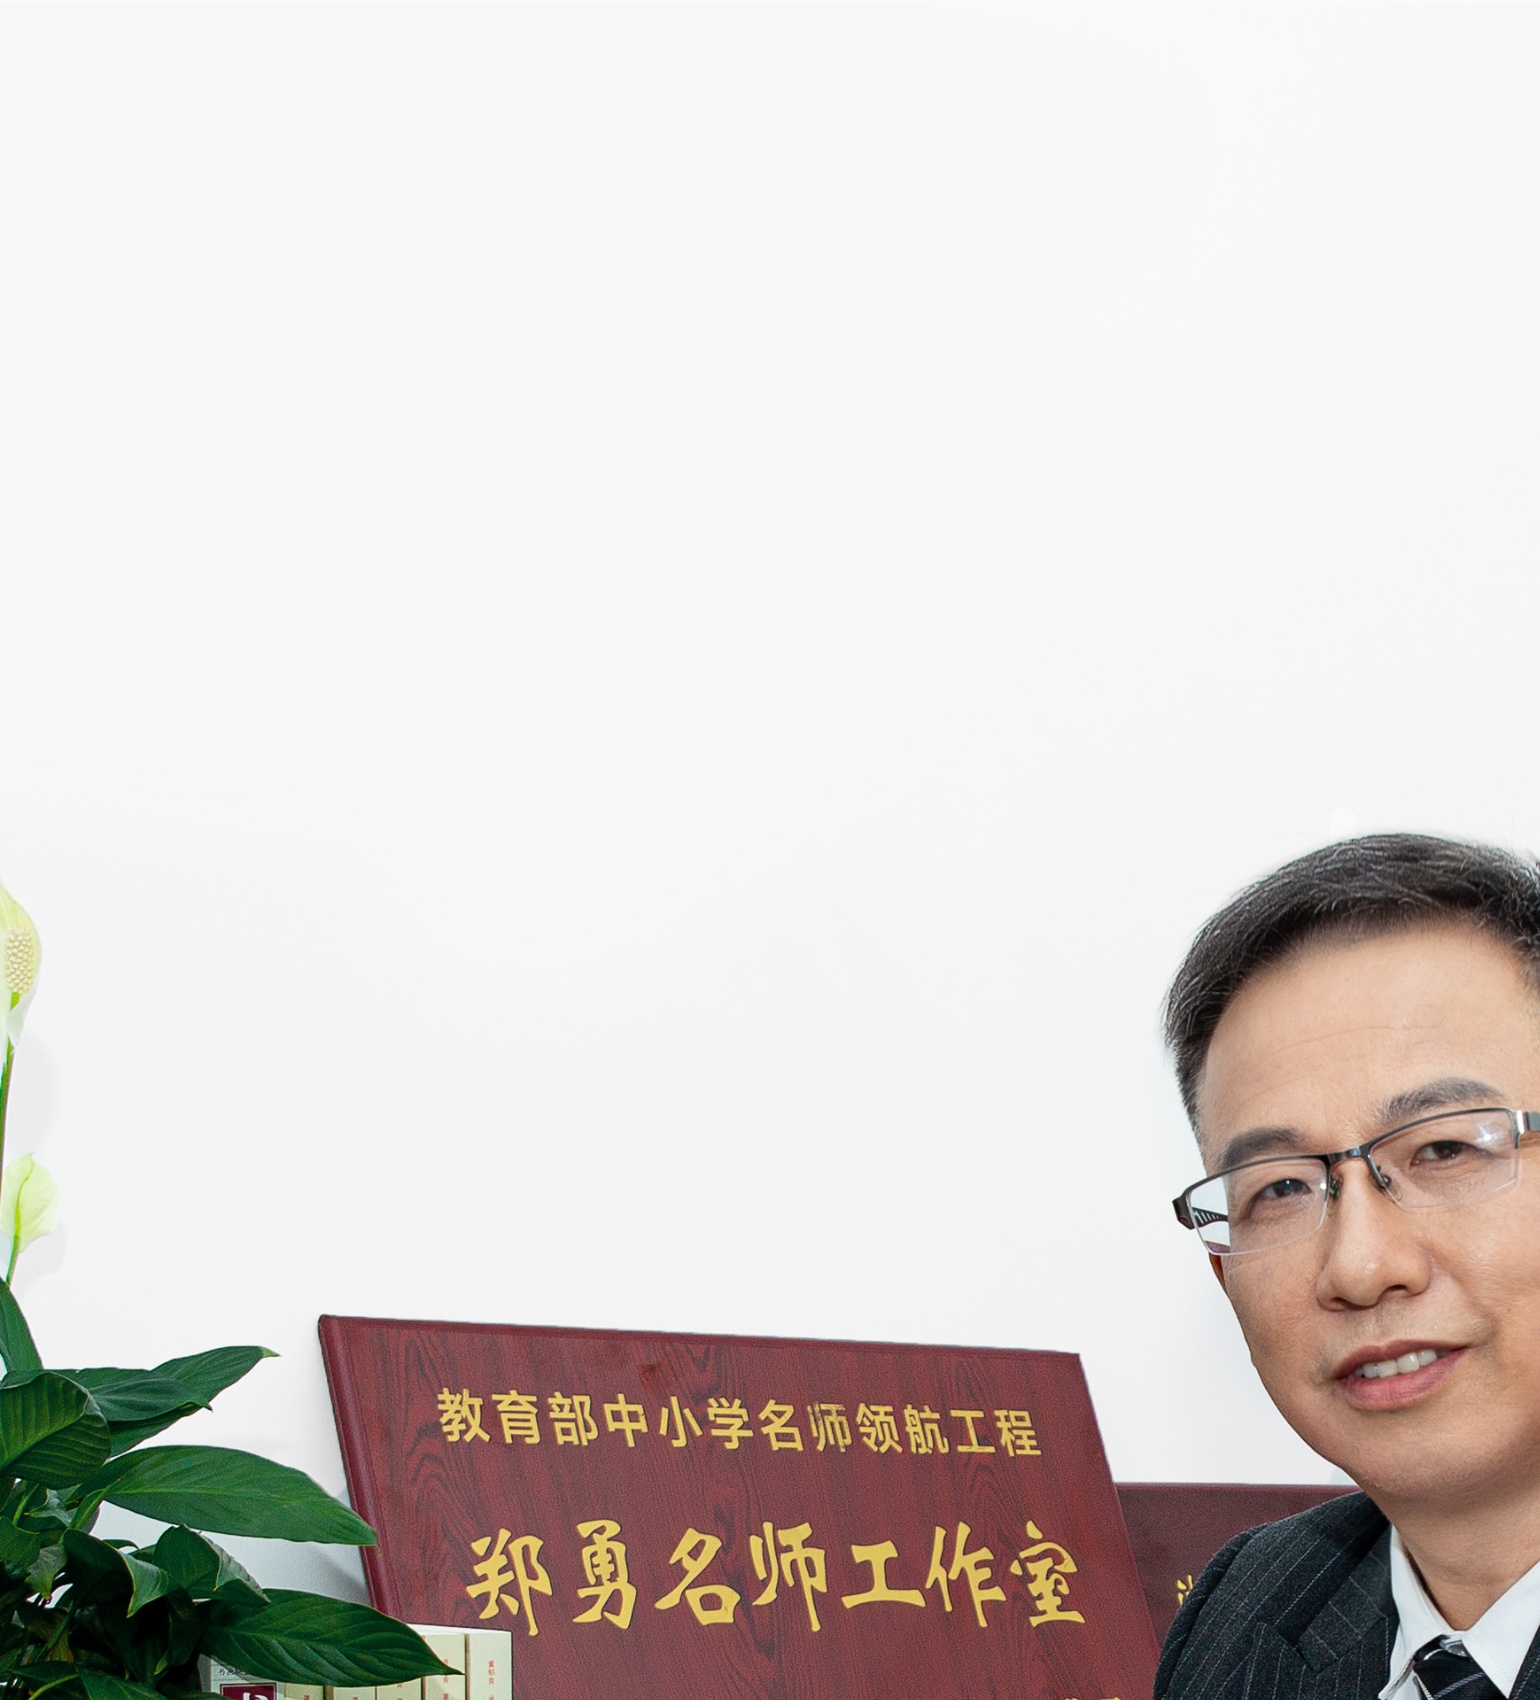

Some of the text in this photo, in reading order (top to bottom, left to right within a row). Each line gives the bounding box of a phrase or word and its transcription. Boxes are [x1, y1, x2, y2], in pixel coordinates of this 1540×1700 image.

[437, 1388, 1042, 1456] 教育部中小学名师领航工程
[466, 1519, 1086, 1636] 郑勇名师工作室
